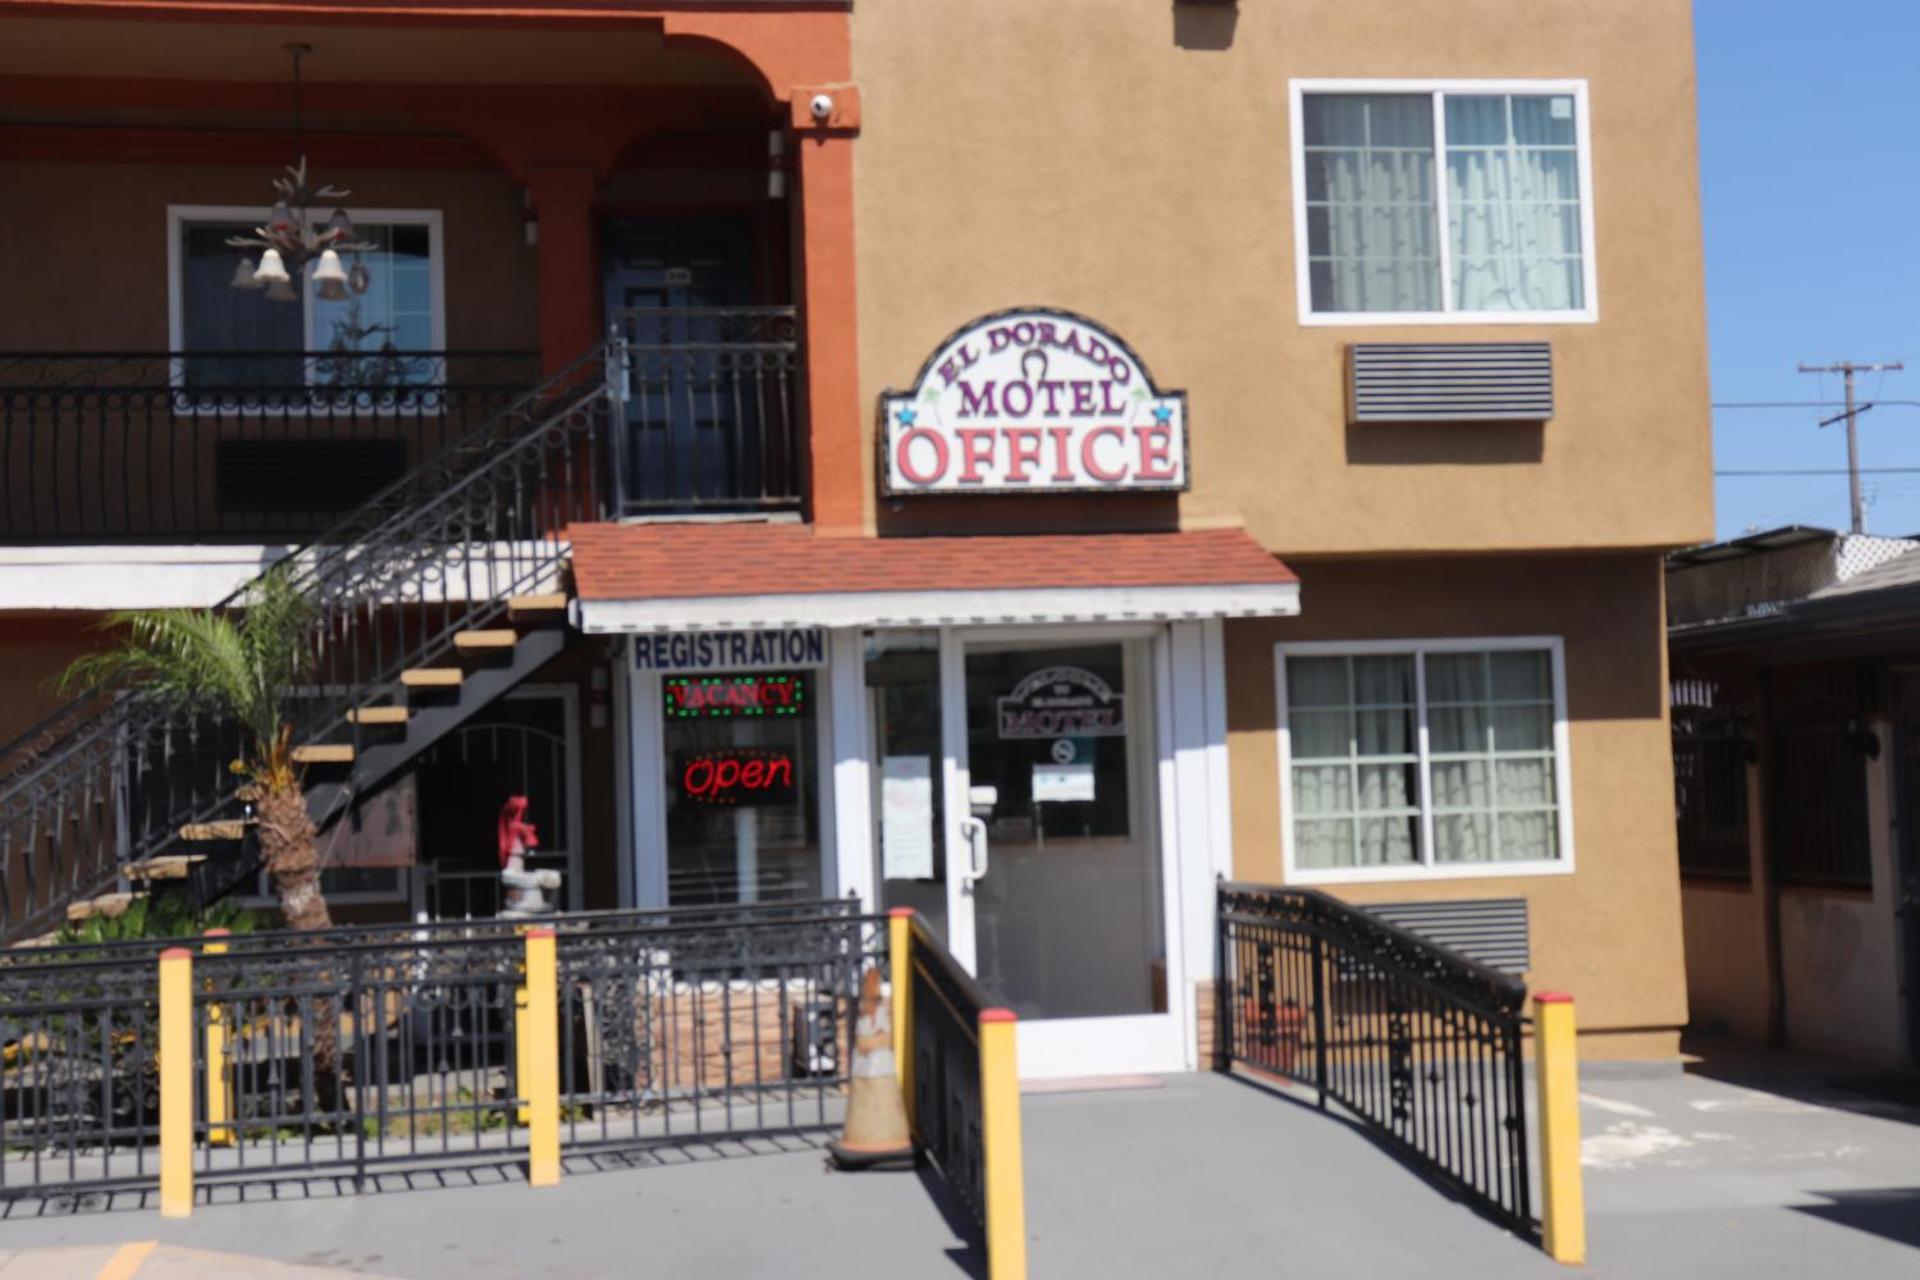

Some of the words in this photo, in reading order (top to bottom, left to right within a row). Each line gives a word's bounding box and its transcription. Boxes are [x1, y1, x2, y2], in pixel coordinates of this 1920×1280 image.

[938, 343, 980, 387] EL
[987, 321, 1131, 386] DORADO
[957, 380, 1126, 418] MOTEL
[896, 424, 1178, 486] OFFICE
[635, 628, 824, 669] REGISTRATION
[669, 681, 793, 707] VACANCY
